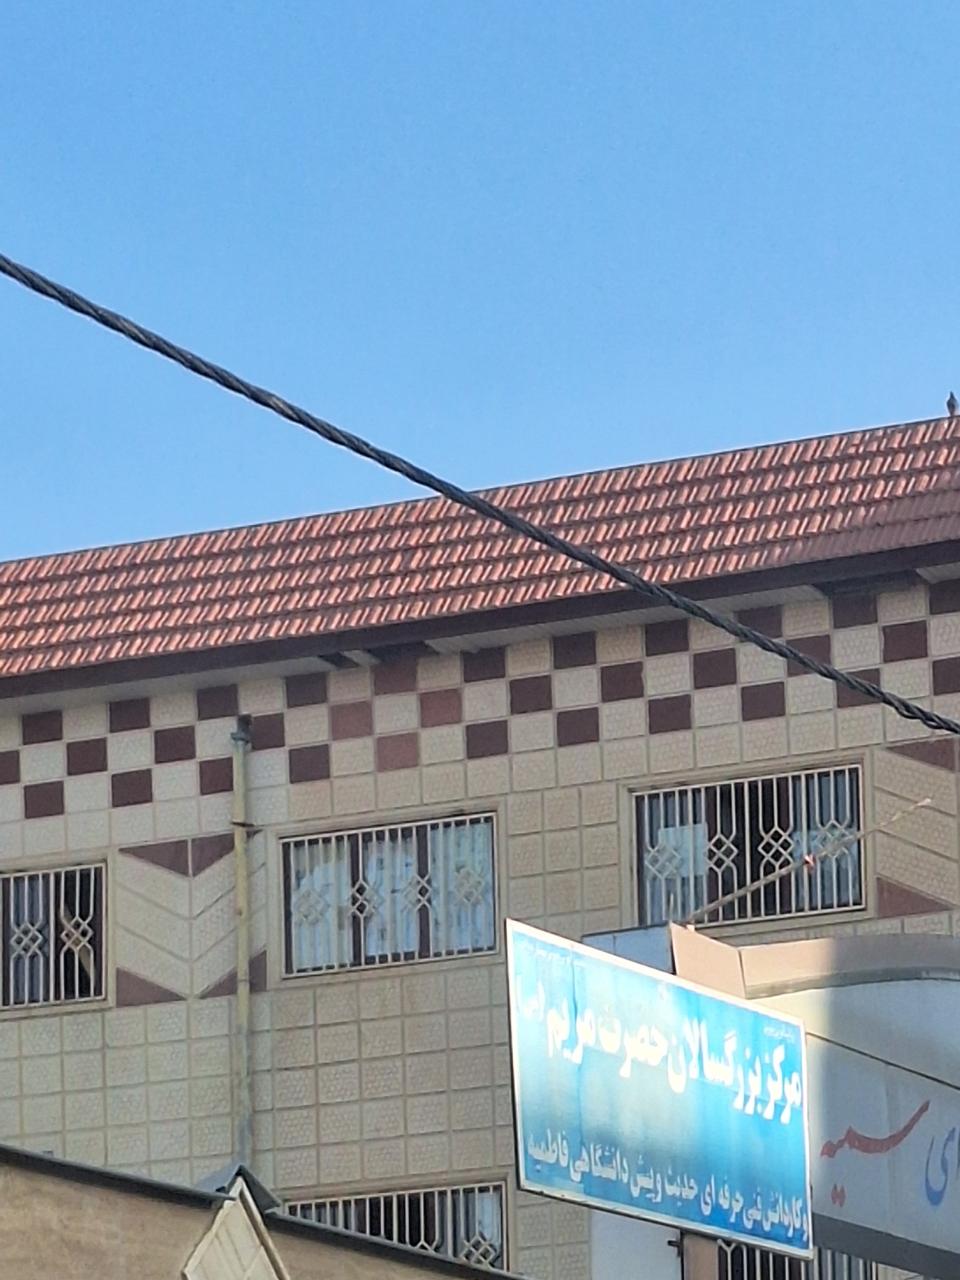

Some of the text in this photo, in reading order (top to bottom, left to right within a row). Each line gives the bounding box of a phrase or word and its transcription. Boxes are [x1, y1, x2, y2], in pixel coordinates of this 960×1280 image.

[666, 1015, 763, 1117] بزرگسالان
[762, 1042, 803, 1125] مرکز
[700, 1173, 717, 1217] ای
